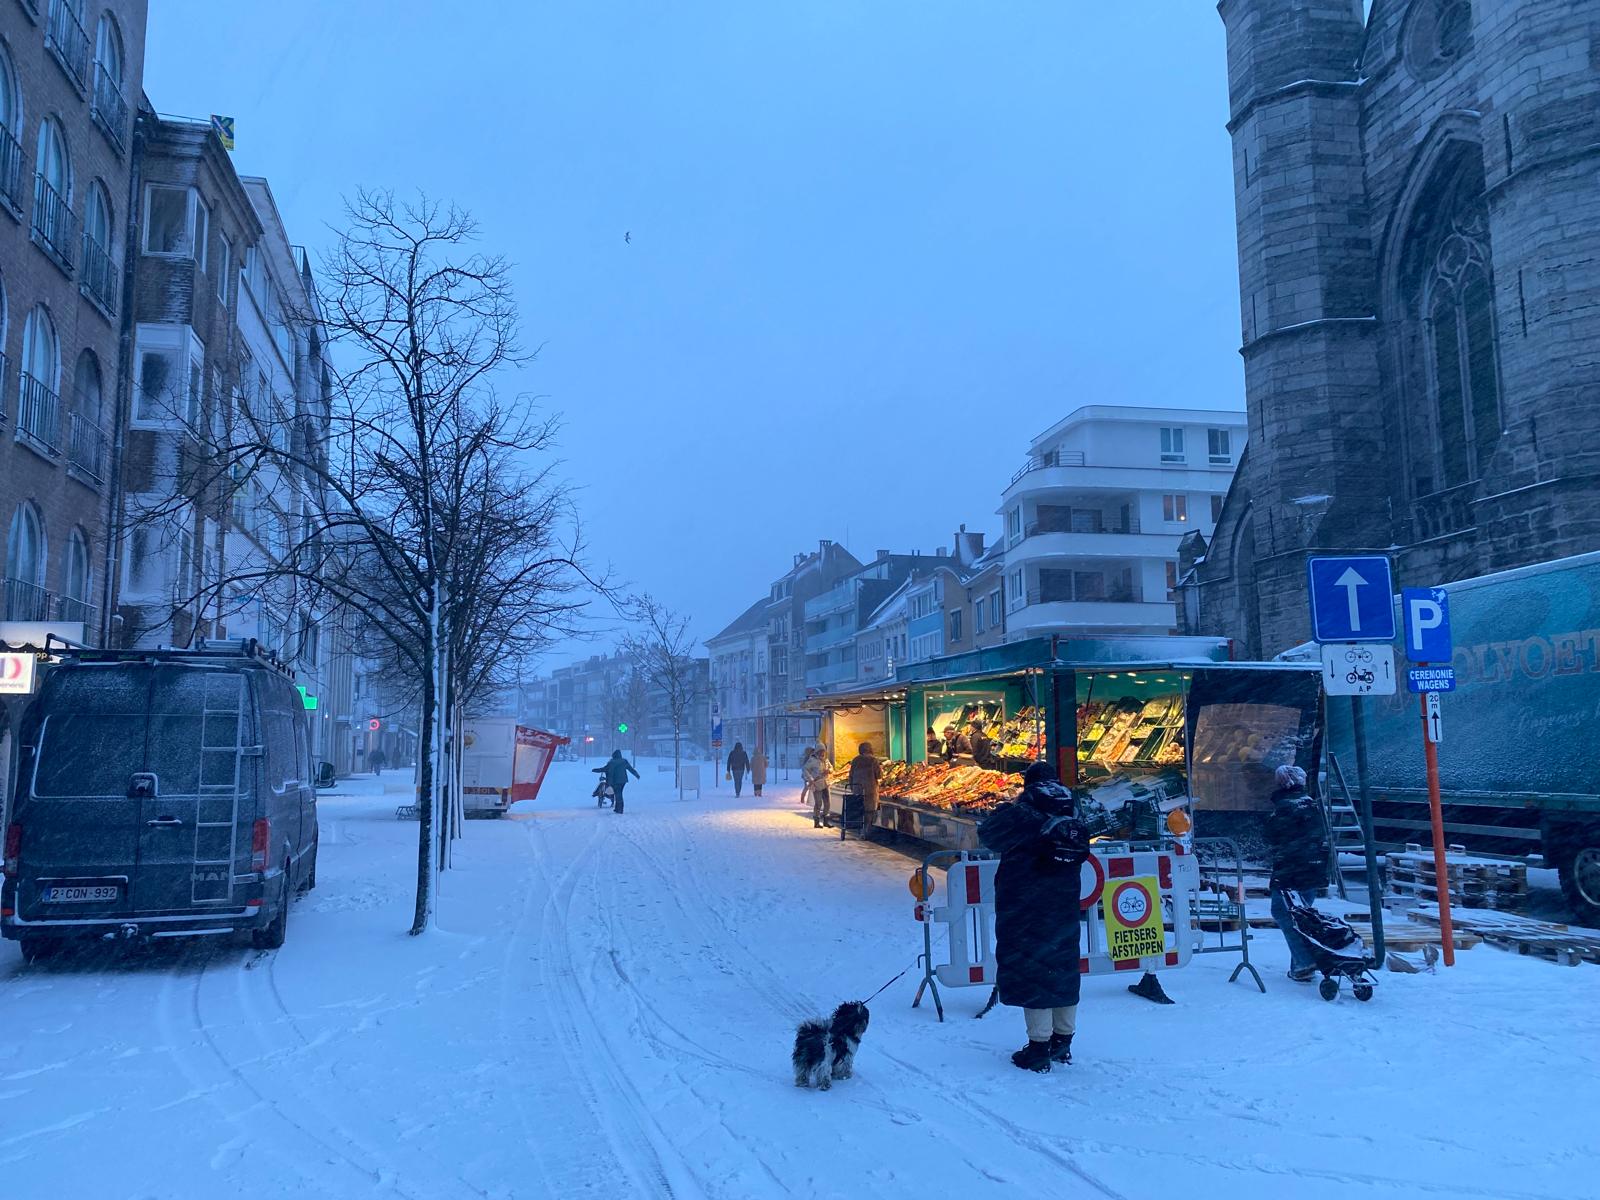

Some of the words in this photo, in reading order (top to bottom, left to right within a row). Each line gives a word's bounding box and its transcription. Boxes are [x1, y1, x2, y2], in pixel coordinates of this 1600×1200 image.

[1410, 599, 1443, 650] P
[1410, 669, 1454, 681] CEREMONIE
[1417, 679, 1450, 690] WAGENS
[1114, 927, 1157, 944] FIETSERS
[1112, 941, 1163, 961] AFSTAPPEN
